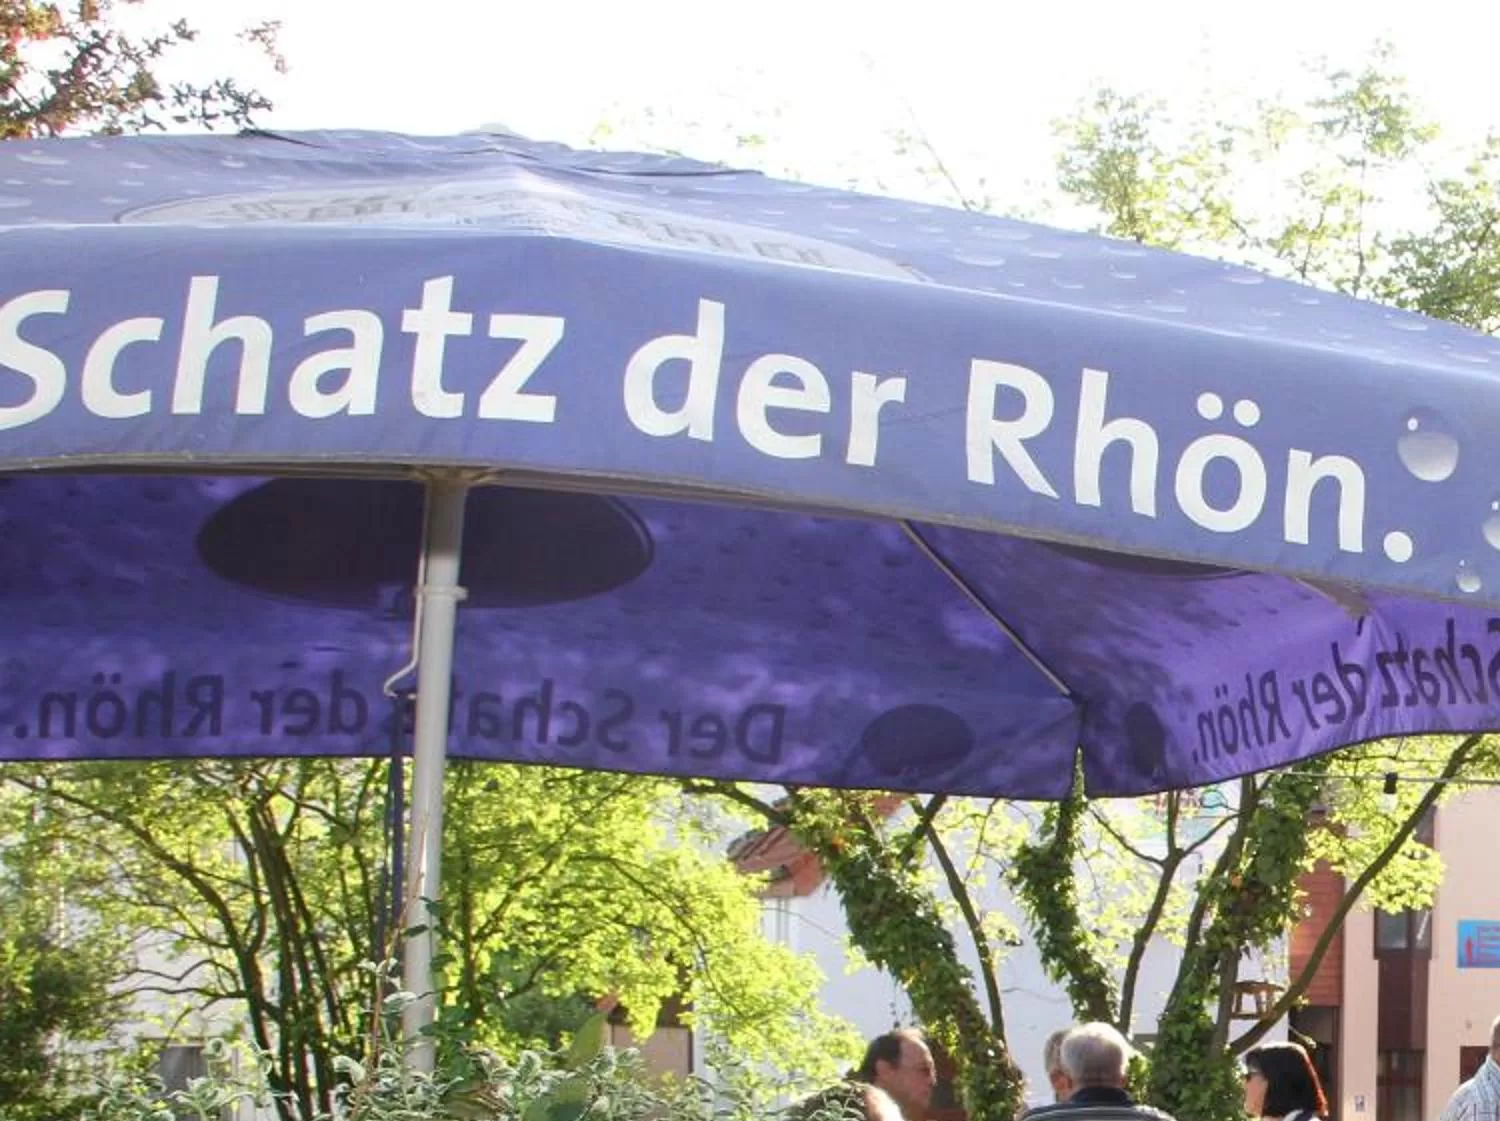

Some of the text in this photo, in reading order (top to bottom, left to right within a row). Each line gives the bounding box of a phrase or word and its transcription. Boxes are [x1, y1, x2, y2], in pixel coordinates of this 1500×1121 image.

[0, 275, 1415, 563] Schatz der Rhön.
